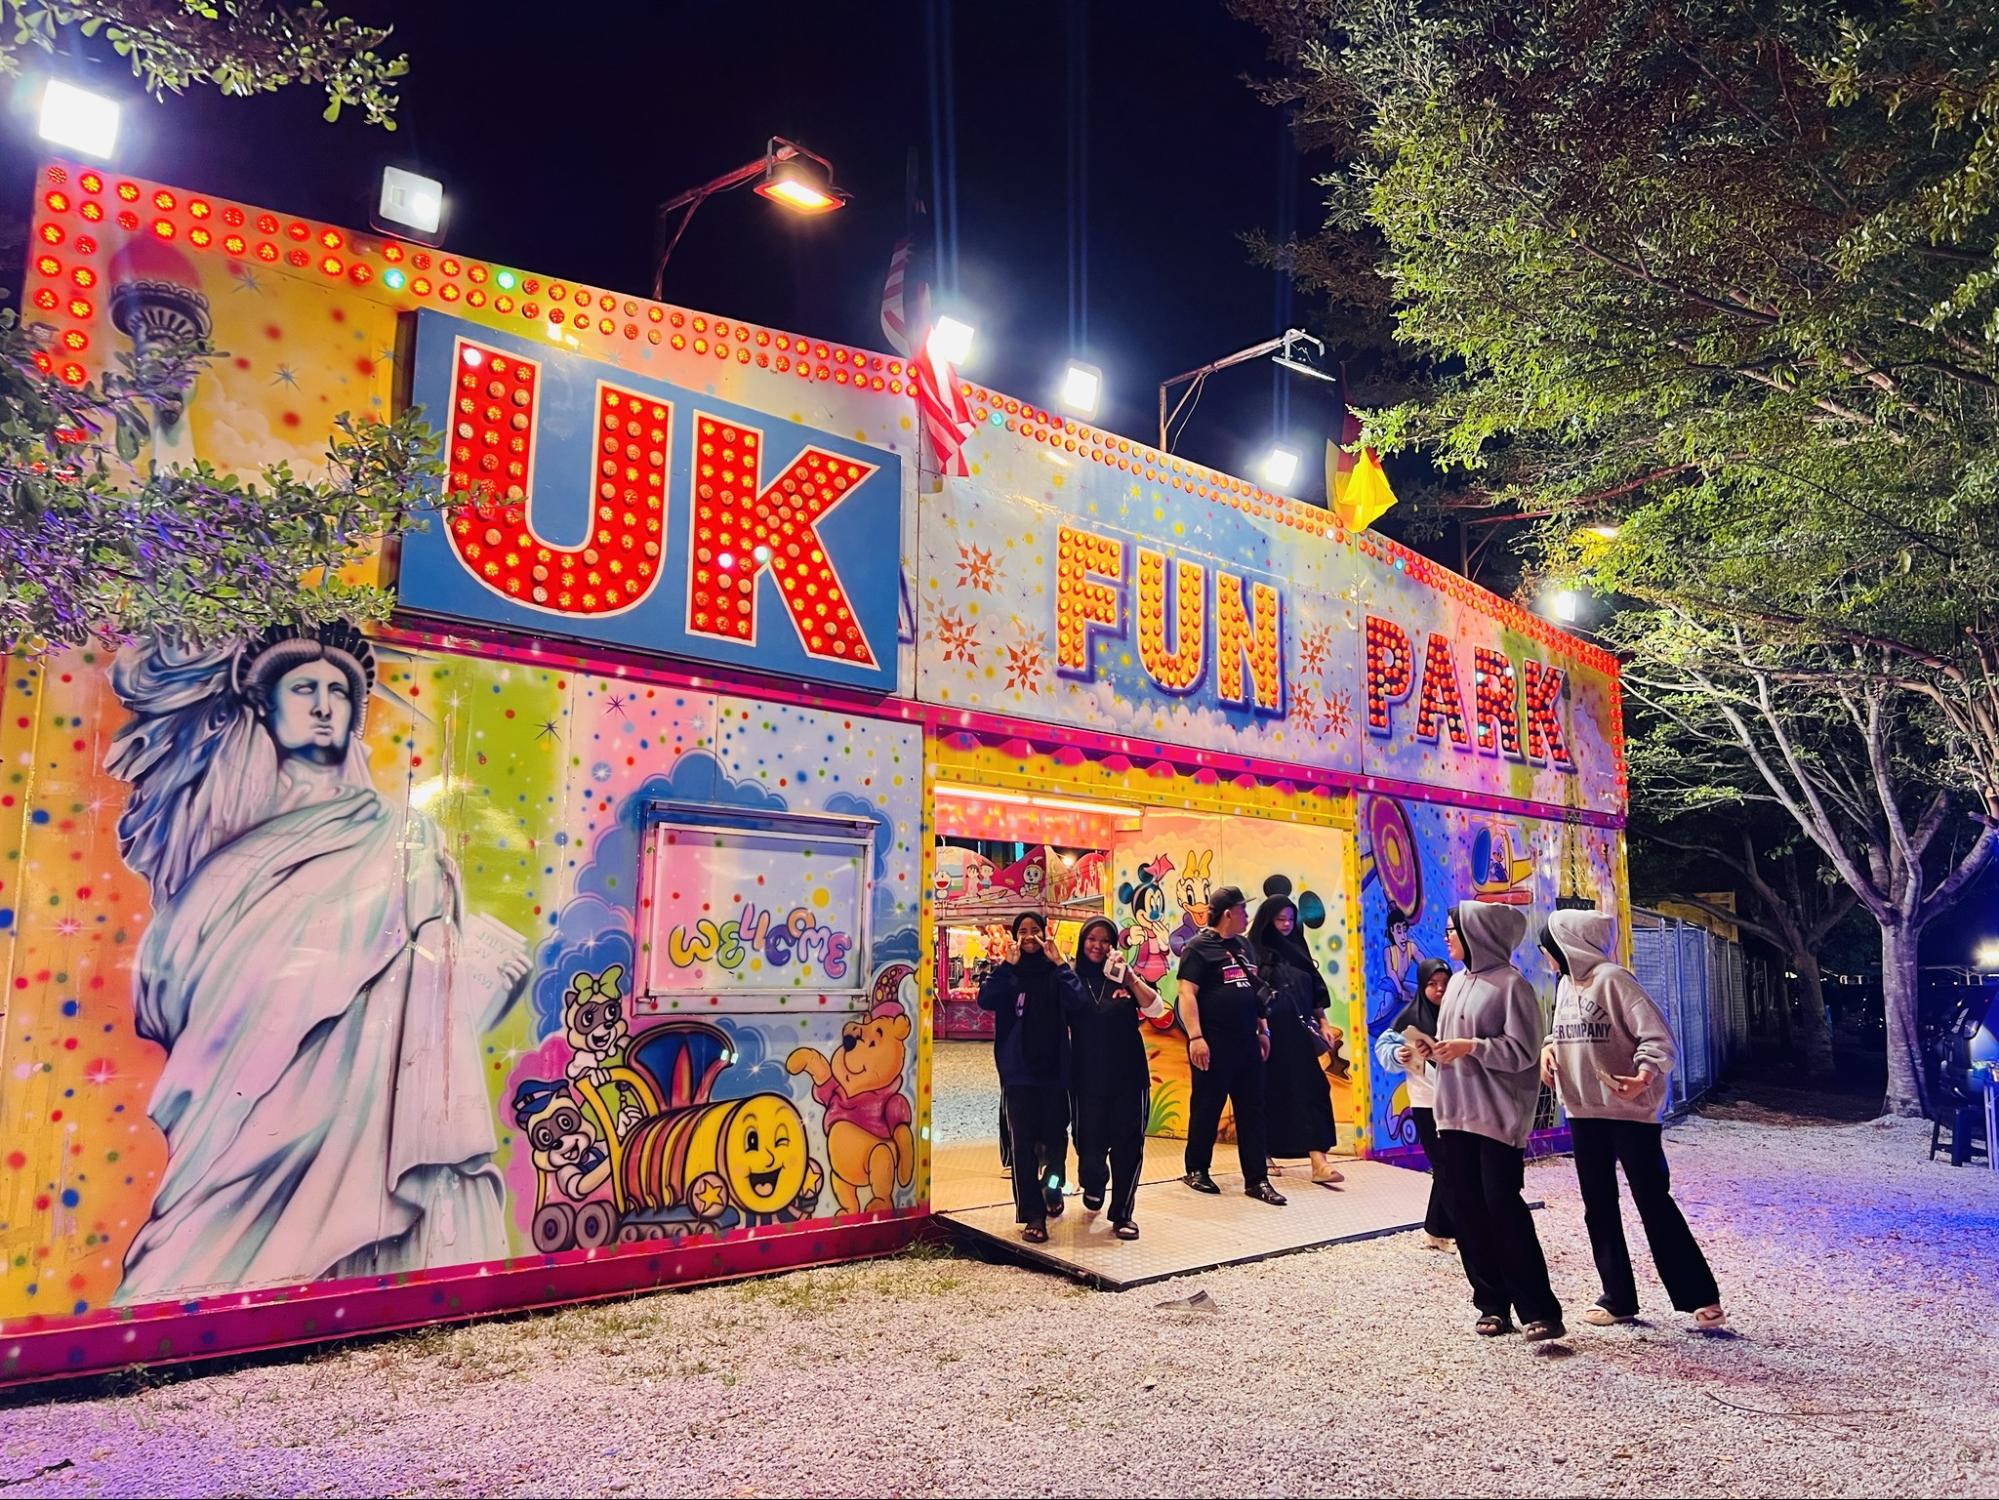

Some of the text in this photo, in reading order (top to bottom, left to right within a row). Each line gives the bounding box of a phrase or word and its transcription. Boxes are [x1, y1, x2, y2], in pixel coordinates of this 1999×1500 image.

[441, 335, 881, 671] UK
[1056, 522, 1281, 714] FUN
[1364, 613, 1572, 766] PARK
[1566, 1022, 1611, 1039] COMPANY
